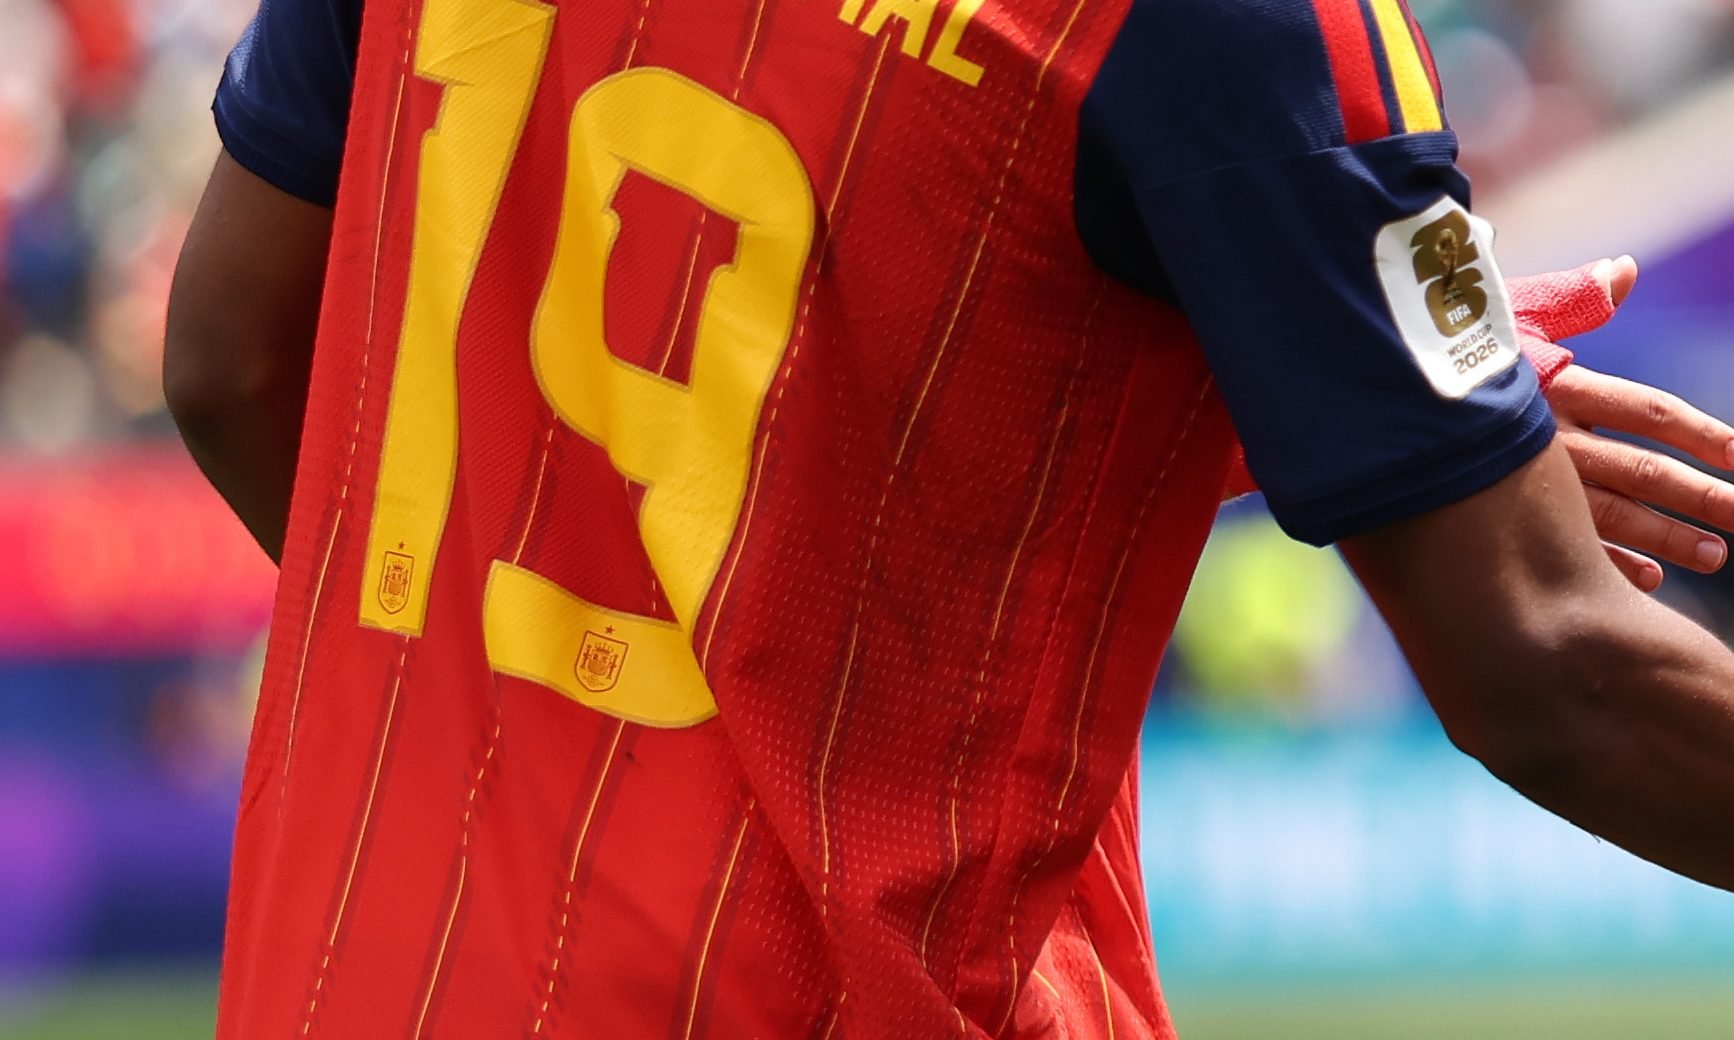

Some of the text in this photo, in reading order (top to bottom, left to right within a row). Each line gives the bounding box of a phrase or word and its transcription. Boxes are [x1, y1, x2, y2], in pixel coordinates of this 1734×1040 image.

[1446, 303, 1472, 325] FIFA
[1447, 323, 1493, 358] WORLD CUP
[1453, 337, 1499, 375] 2026
